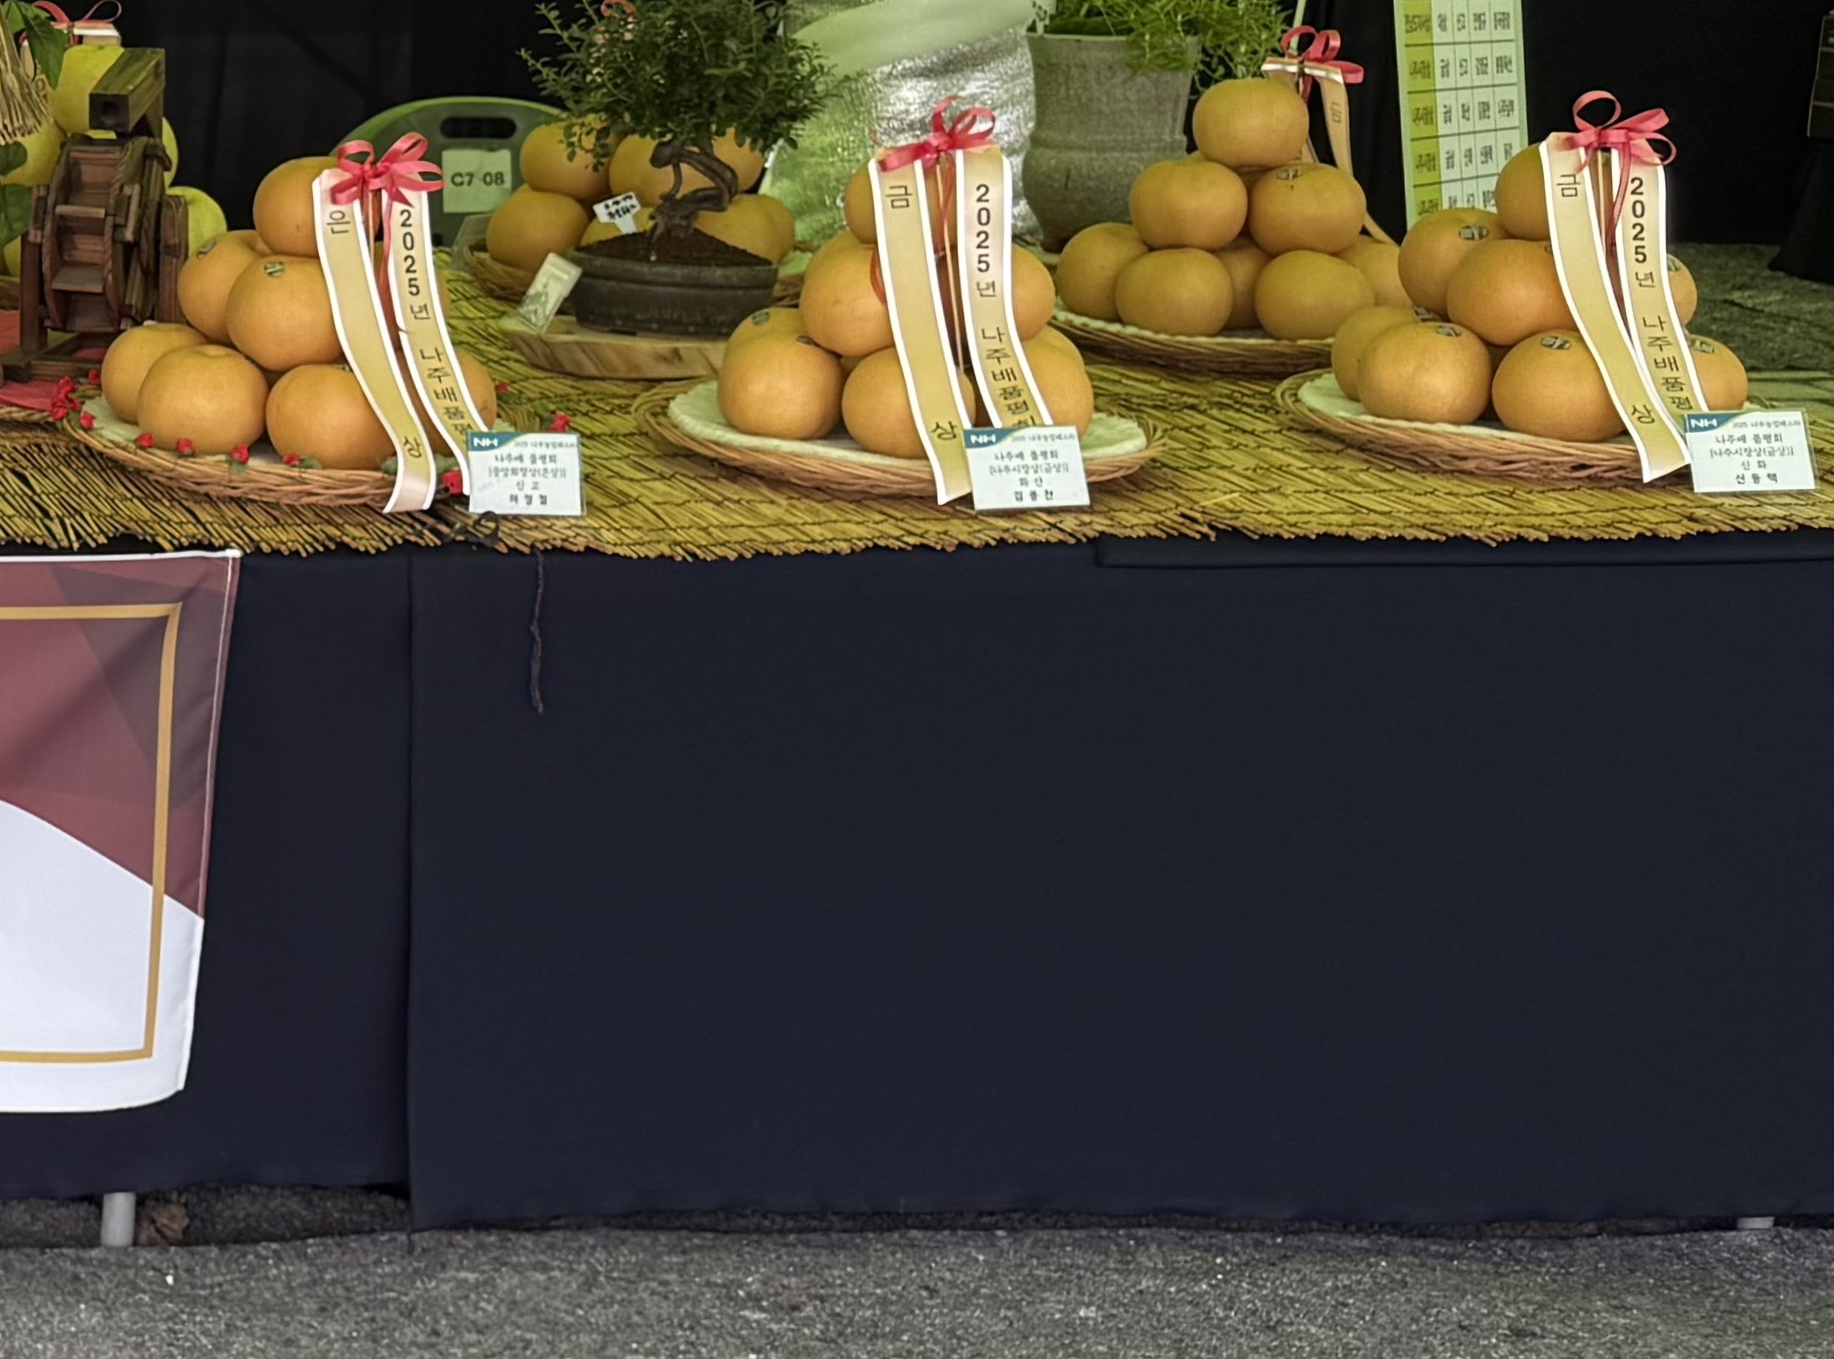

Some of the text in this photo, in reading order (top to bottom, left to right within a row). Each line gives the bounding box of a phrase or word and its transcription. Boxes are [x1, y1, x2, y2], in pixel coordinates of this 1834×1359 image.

[974, 182, 999, 300] 2025년
[1628, 175, 1658, 291] 2025년
[398, 208, 433, 322] 2025년
[884, 183, 959, 442] 금 상
[1555, 172, 1657, 426] 금 상
[324, 209, 424, 460] 은 상
[473, 437, 498, 447] NH
[970, 435, 996, 444] NH
[1690, 419, 1717, 428] NH
[1716, 434, 1746, 445] 나주배
[495, 454, 524, 463] 나주배
[995, 451, 1025, 462] 나주배
